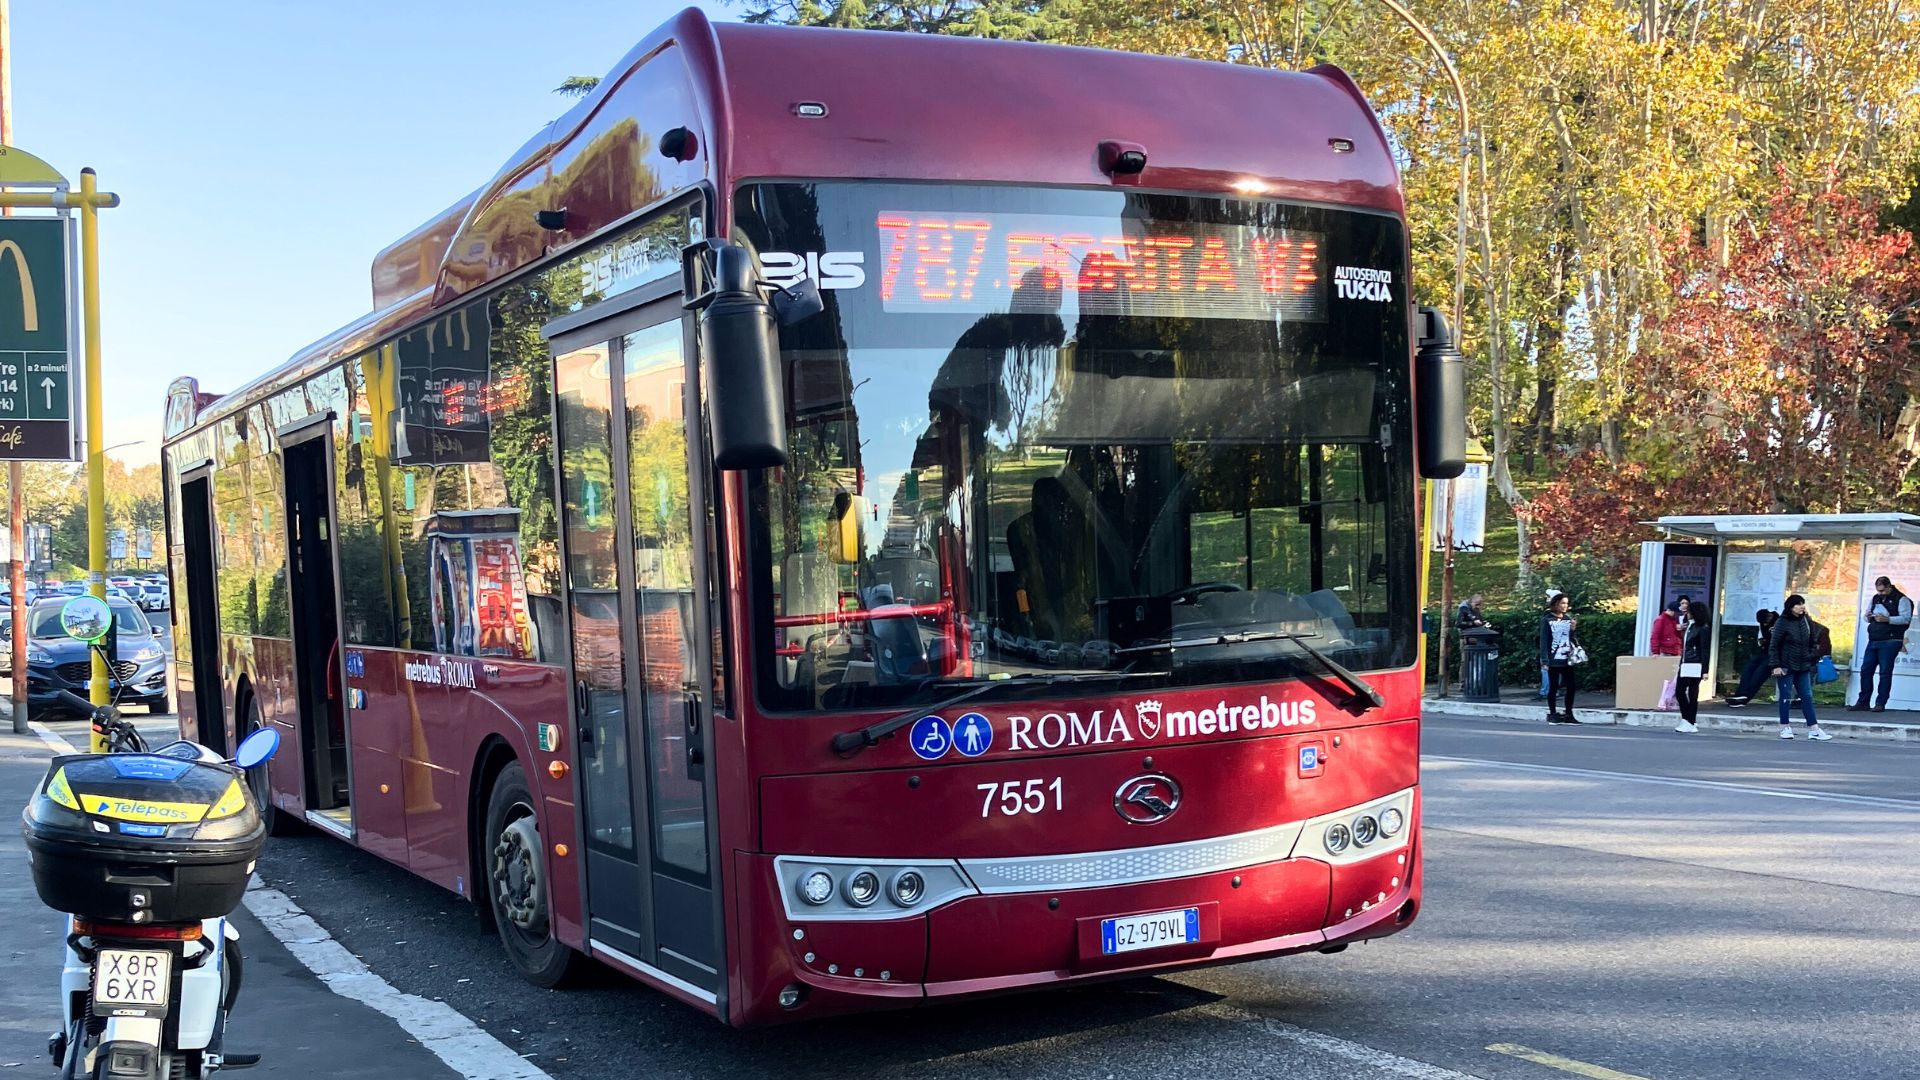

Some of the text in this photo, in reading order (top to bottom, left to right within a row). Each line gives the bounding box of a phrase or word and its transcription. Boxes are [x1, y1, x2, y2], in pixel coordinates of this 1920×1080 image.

[618, 253, 650, 280] TUSCIA
[760, 251, 865, 290] BIS
[1335, 265, 1392, 284] AUTOSERVIZI
[1334, 279, 1392, 303] TUSCIA
[0, 362, 17, 375] re
[34, 364, 39, 372] 2
[41, 364, 67, 372] minuti
[0, 379, 18, 393] 14
[0, 397, 14, 411] k)
[405, 659, 476, 689] metrebus ROMA
[1007, 708, 1134, 750] ROMA
[1167, 696, 1316, 738] metrebus
[977, 776, 1063, 817] 7551
[114, 802, 188, 819] Telepass
[109, 954, 158, 977] X8R
[106, 978, 156, 1001] 6XR
